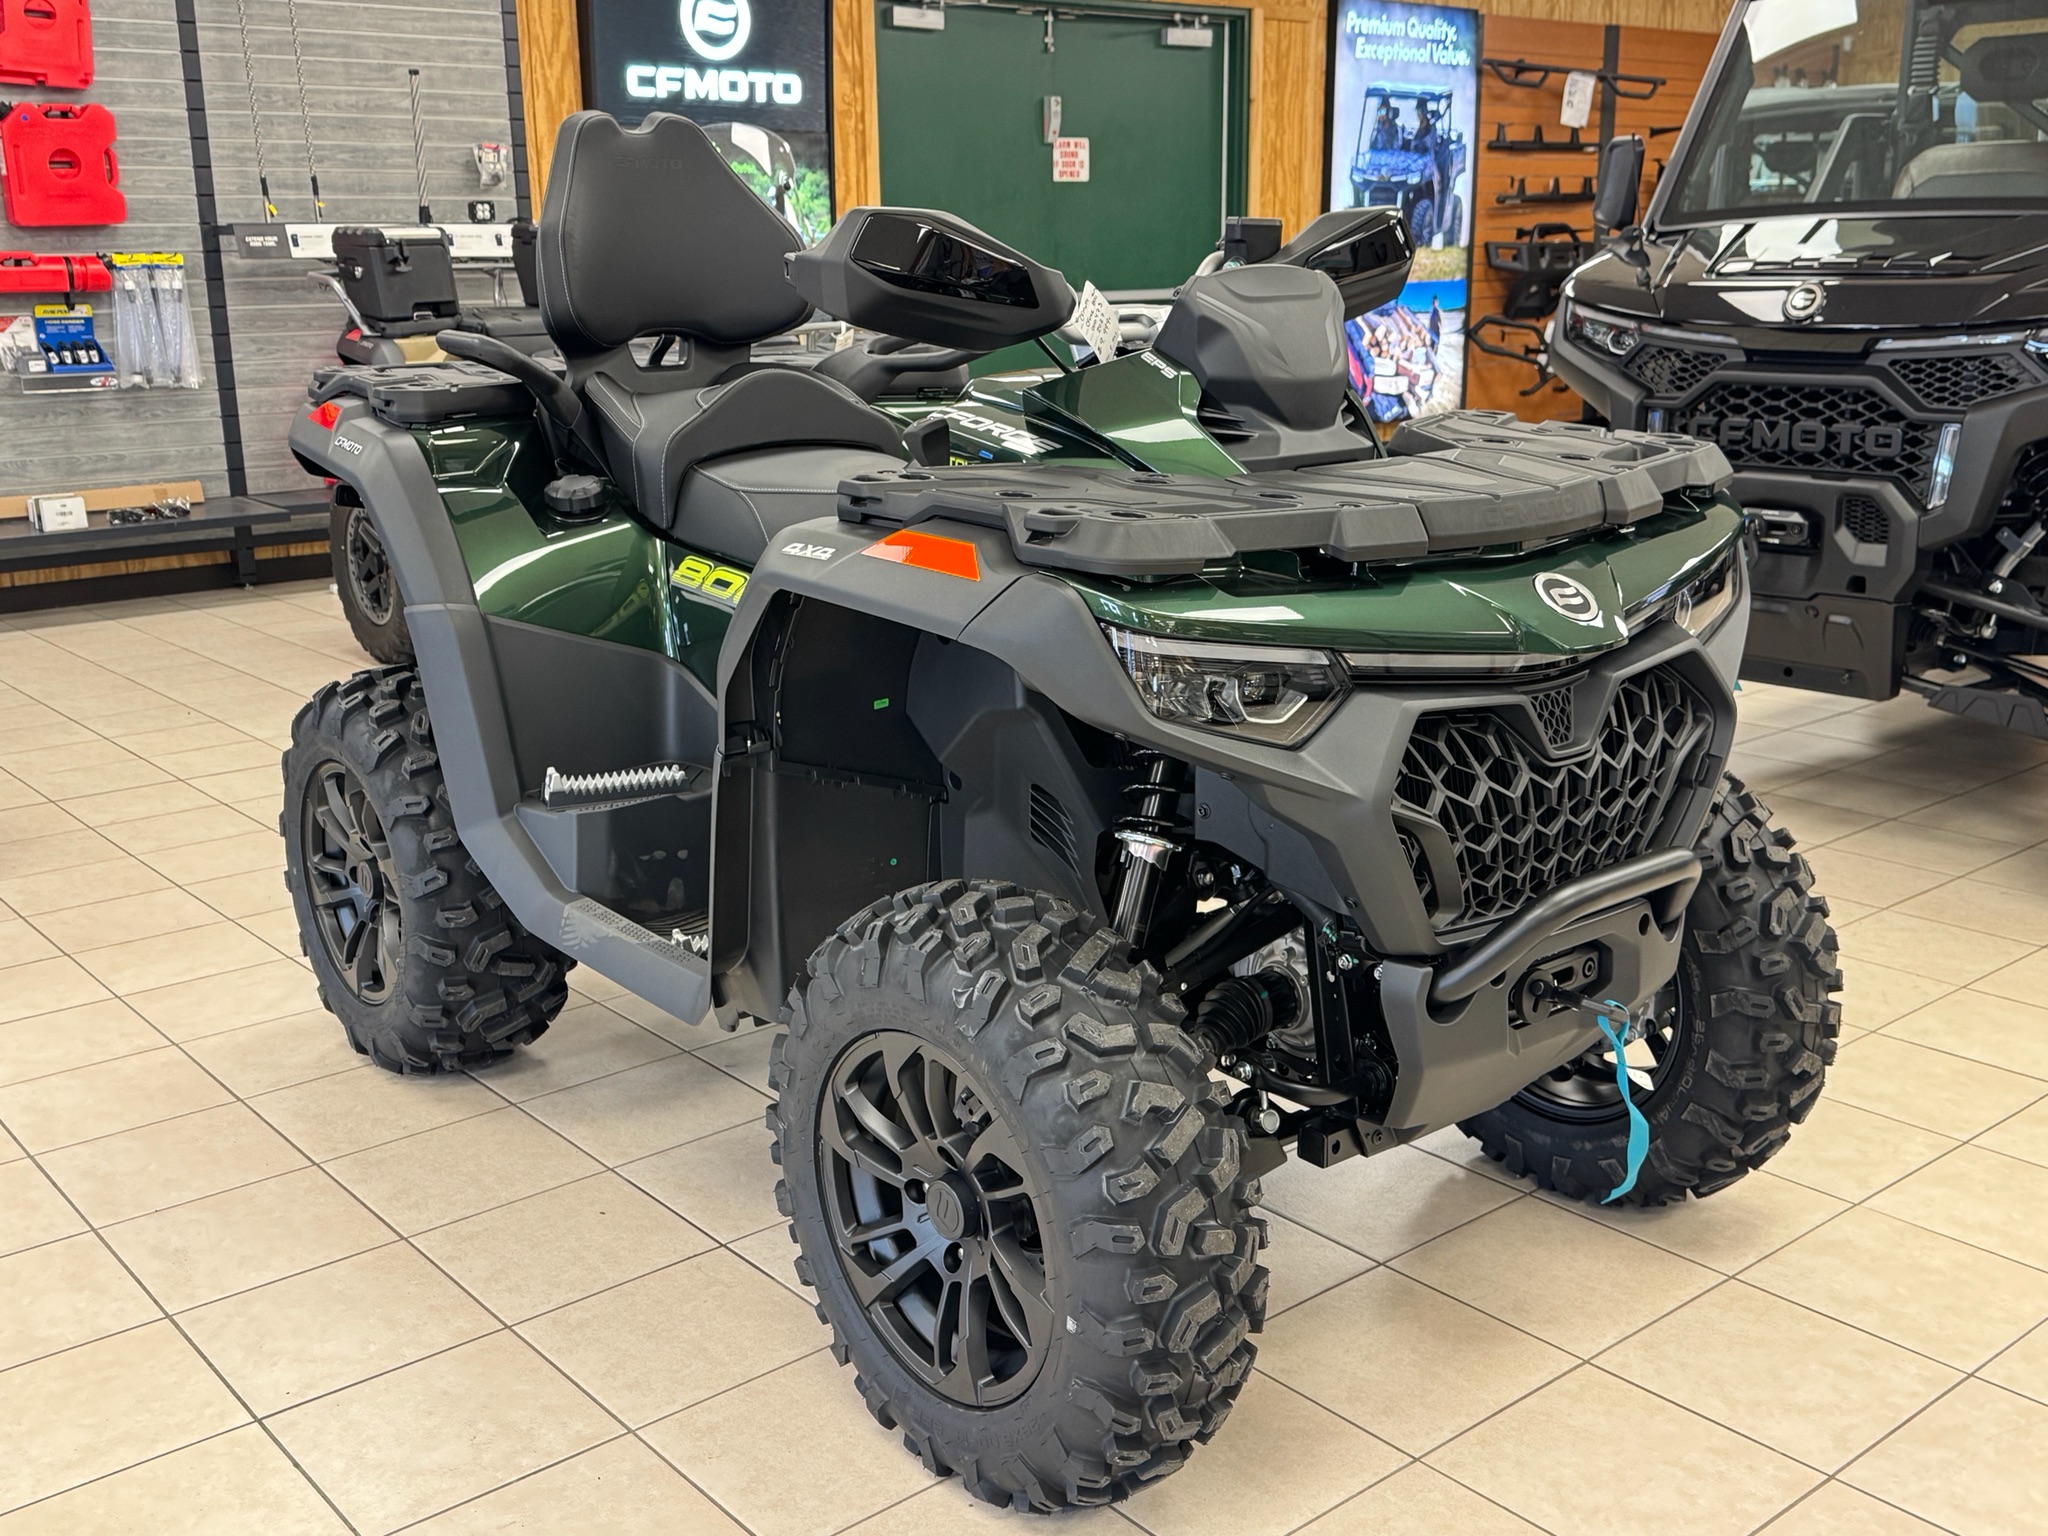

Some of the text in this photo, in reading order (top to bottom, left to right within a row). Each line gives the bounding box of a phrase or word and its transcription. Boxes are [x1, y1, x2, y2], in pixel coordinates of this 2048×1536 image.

[1346, 10, 1405, 36] Premium
[1355, 36, 1431, 66] Exceptional
[626, 65, 802, 104] CFMOTO
[1054, 141, 1071, 149] LARM
[1141, 351, 1178, 379] EPS
[334, 435, 363, 455] CFMOTO
[1687, 416, 1902, 457] CFMOTO
[781, 542, 836, 561] 4X4
[671, 555, 750, 604] 80
